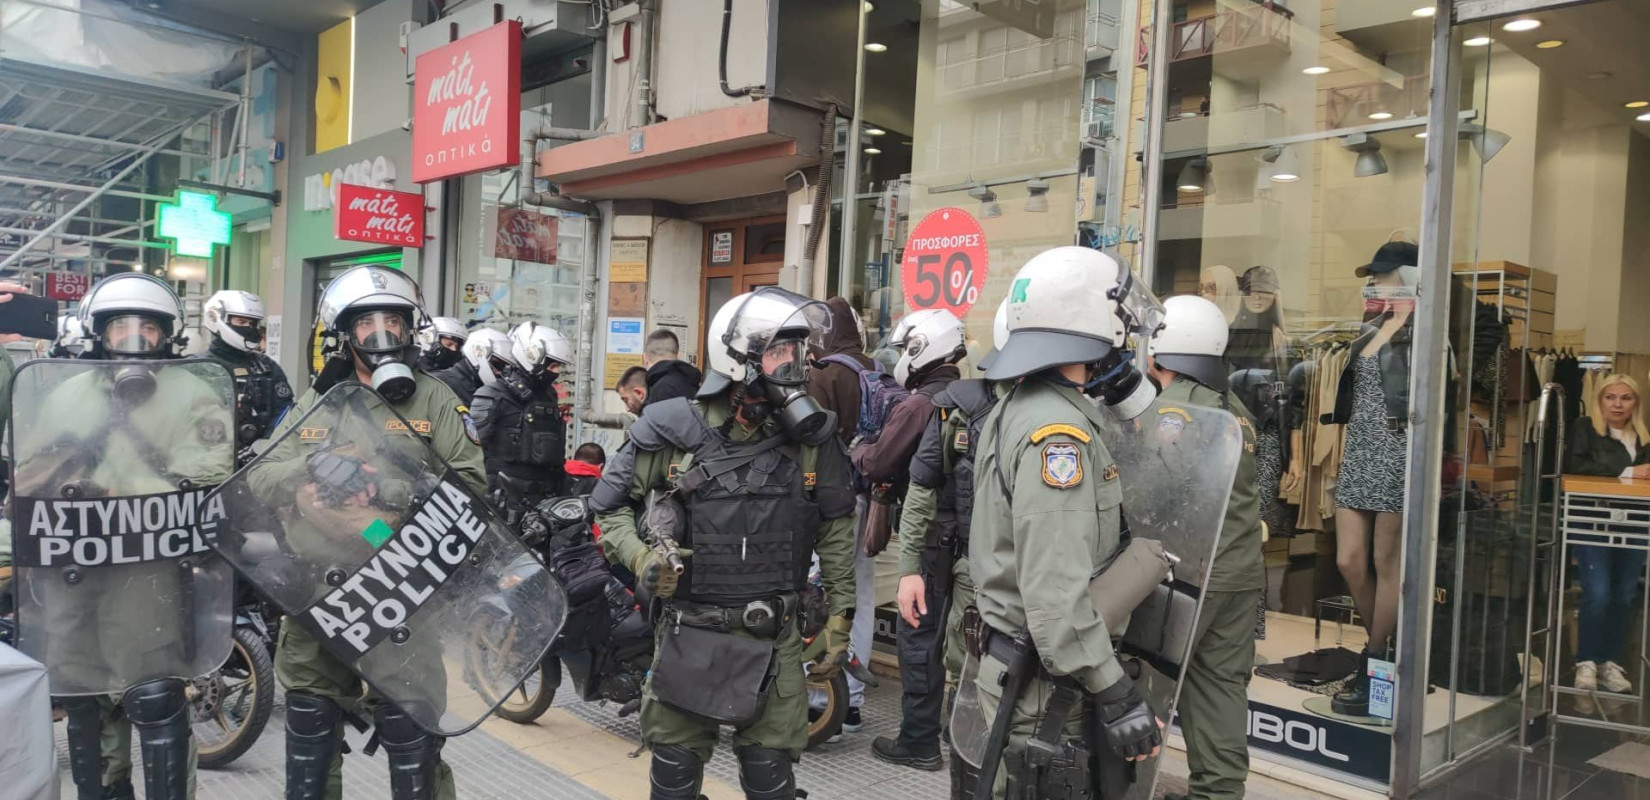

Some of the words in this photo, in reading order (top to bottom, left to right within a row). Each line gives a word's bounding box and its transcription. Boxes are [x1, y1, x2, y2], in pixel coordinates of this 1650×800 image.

[912, 234, 979, 251] ΠΡΟΣΦΟΡΕΣ
[387, 420, 429, 431] POCE
[29, 490, 227, 537] ΑΣΤΥΝΟΜΙΑ
[40, 522, 218, 566] POLICE
[310, 480, 471, 638] ΑΣΤΥΝΟΜΙΑ
[341, 508, 487, 653] POLICE
[1371, 695, 1389, 703] FREE
[1372, 681, 1392, 690] SHOP
[1372, 688, 1385, 696] TAX
[1247, 709, 1349, 761] BOL
